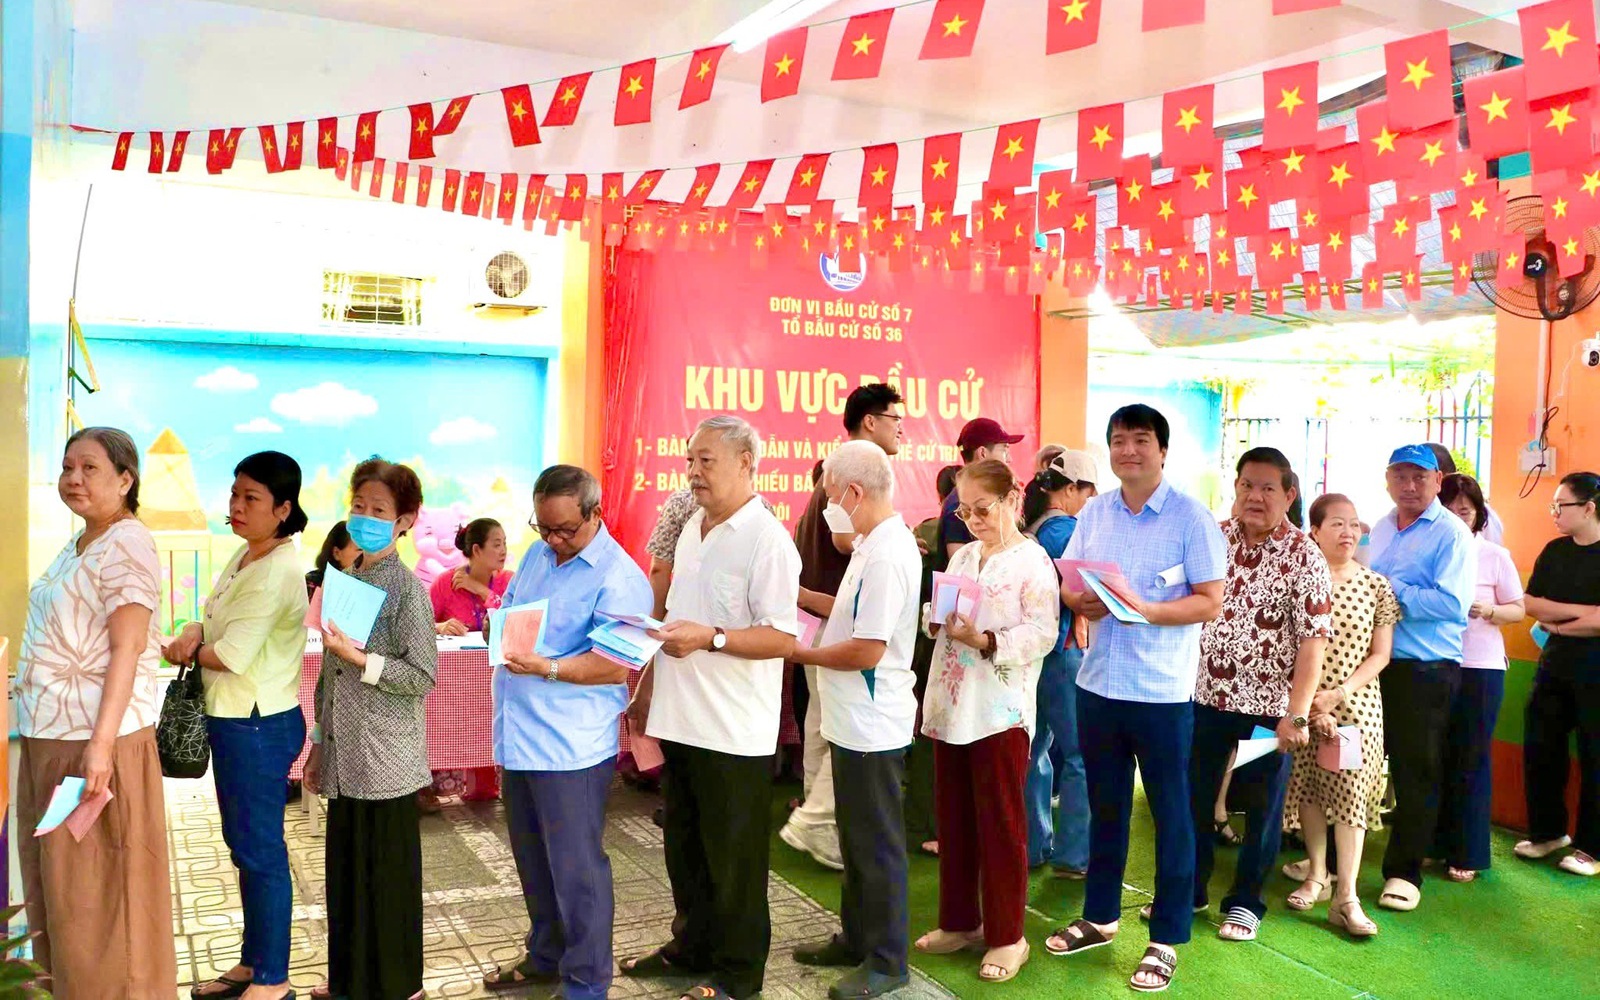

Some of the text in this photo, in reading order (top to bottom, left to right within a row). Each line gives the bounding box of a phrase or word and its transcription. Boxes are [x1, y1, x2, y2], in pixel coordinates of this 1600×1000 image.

[770, 297, 912, 322] ĐƠN VỊ BẦU CỬ SỐ 7
[782, 315, 902, 342] TỔ BẦU CỬ SỐ 36
[685, 365, 764, 412] KHU
[776, 368, 848, 423] VỰC
[938, 368, 984, 420] CỬ
[793, 437, 812, 459] VÀ
[893, 439, 912, 461] HẺ
[917, 440, 937, 461] CỬ
